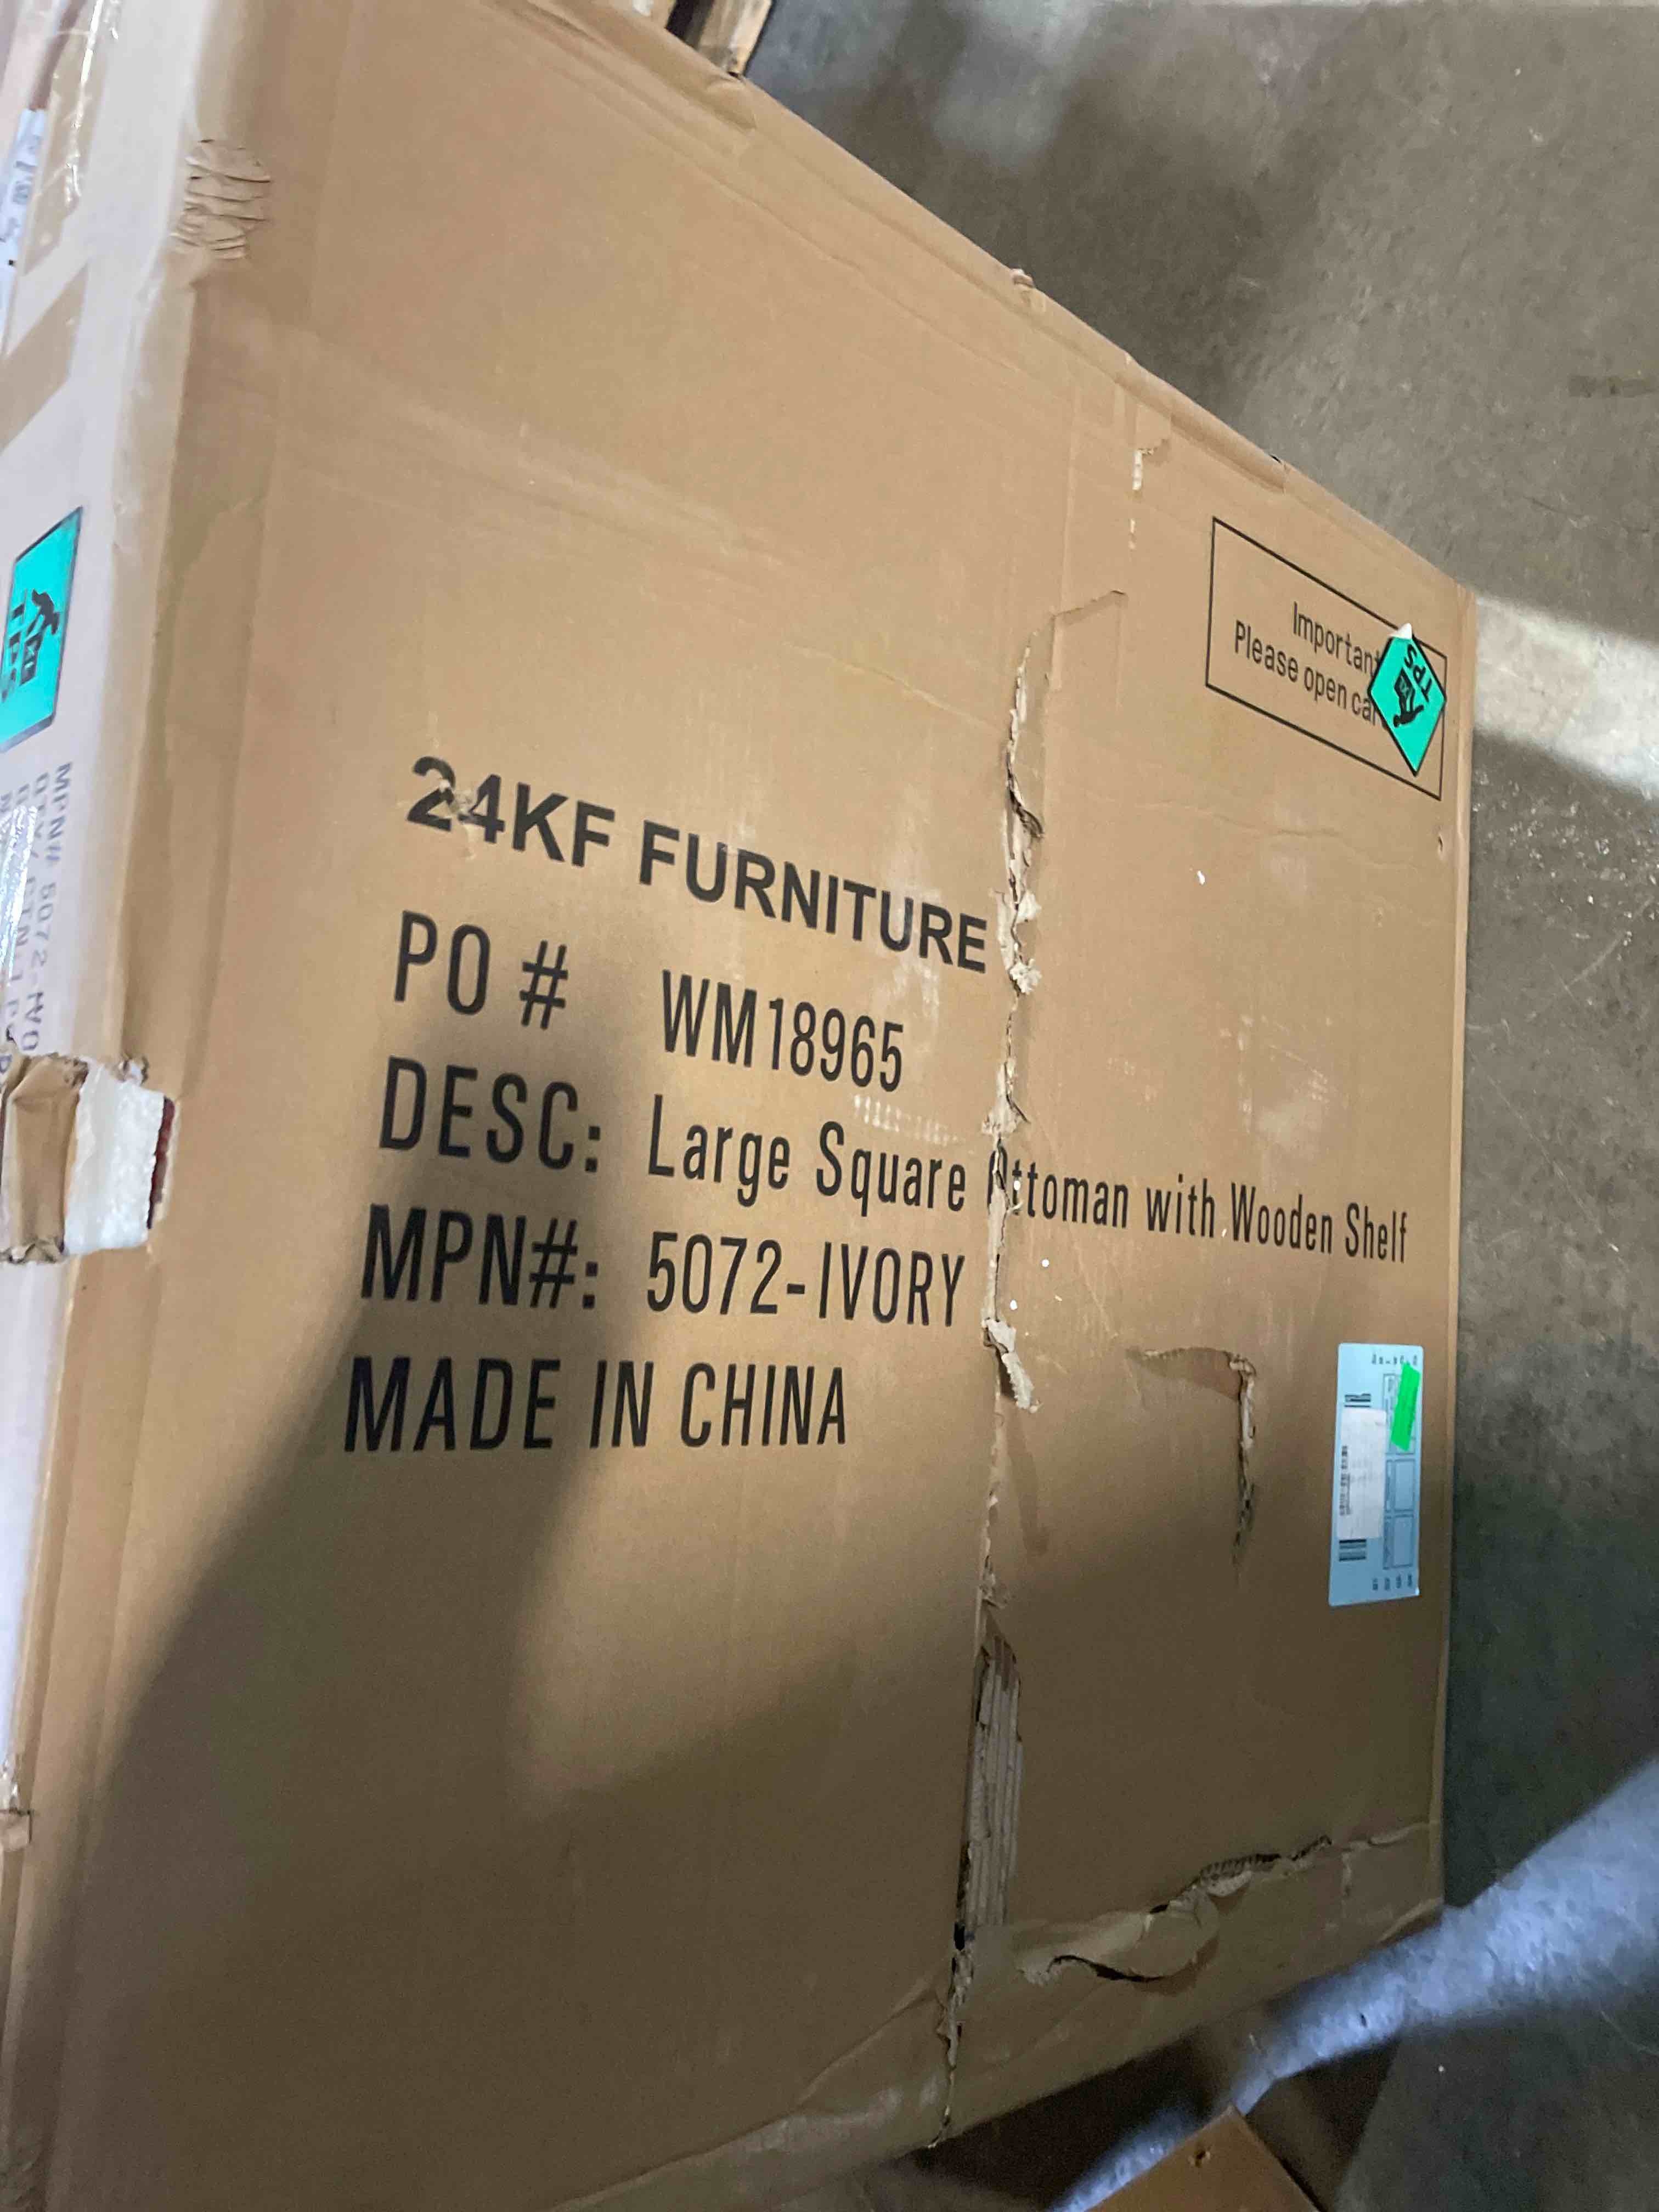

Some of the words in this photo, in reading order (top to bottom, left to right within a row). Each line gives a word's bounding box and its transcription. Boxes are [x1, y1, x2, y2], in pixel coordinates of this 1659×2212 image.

[1234, 620, 1299, 683] Please
[1304, 665, 1347, 709] open
[406, 755, 615, 868] 24KF
[638, 820, 989, 974] FURNITURE
[393, 910, 492, 1016] PO
[518, 939, 569, 1030] #
[661, 969, 905, 1093] WM18965
[379, 1054, 602, 1175] DESC:
[647, 1093, 790, 1207] Large
[816, 1120, 967, 1217] Square
[1147, 1173, 1215, 1238] with
[1231, 1181, 1333, 1255] Wooden
[1345, 1202, 1408, 1263] Shelf
[360, 1203, 599, 1310] MPN#:
[646, 1231, 966, 1328] 5072-IVORY
[343, 1355, 561, 1452] MADE
[589, 1359, 654, 1449] IN
[679, 1362, 847, 1448] CHINA
